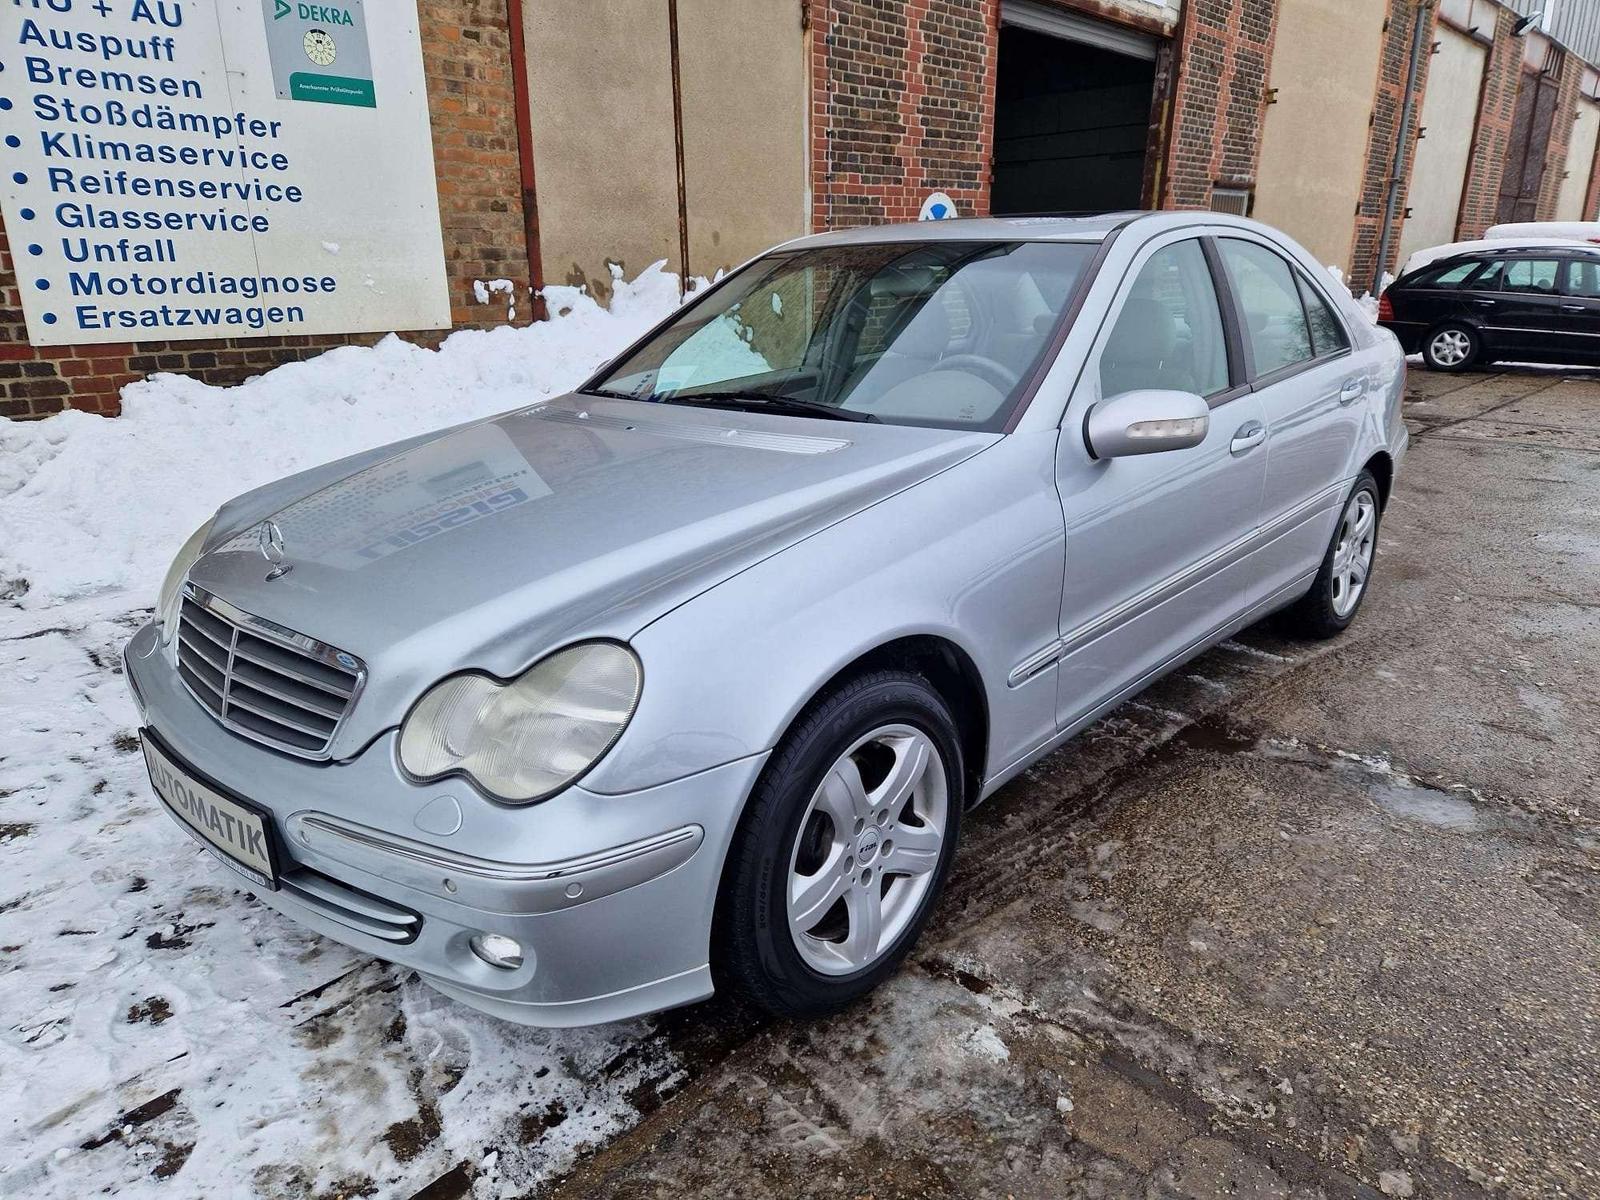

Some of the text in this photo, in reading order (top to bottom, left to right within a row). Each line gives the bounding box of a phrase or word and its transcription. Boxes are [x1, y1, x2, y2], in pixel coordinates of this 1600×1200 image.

[131, 0, 182, 27] AU
[298, 3, 353, 26] DEKRA
[19, 18, 175, 62] Auspuff
[25, 56, 202, 99] Bremsen
[33, 94, 281, 138] Stoßdämpfer
[41, 131, 289, 171] Klimaservice
[48, 167, 302, 202] Reifenservice
[56, 202, 269, 232] Glasservice
[62, 238, 177, 263] Unfall
[69, 272, 336, 299] Motordiagnose
[76, 303, 304, 329] Ersatzwagen
[149, 750, 268, 862] AUTOMATIK
